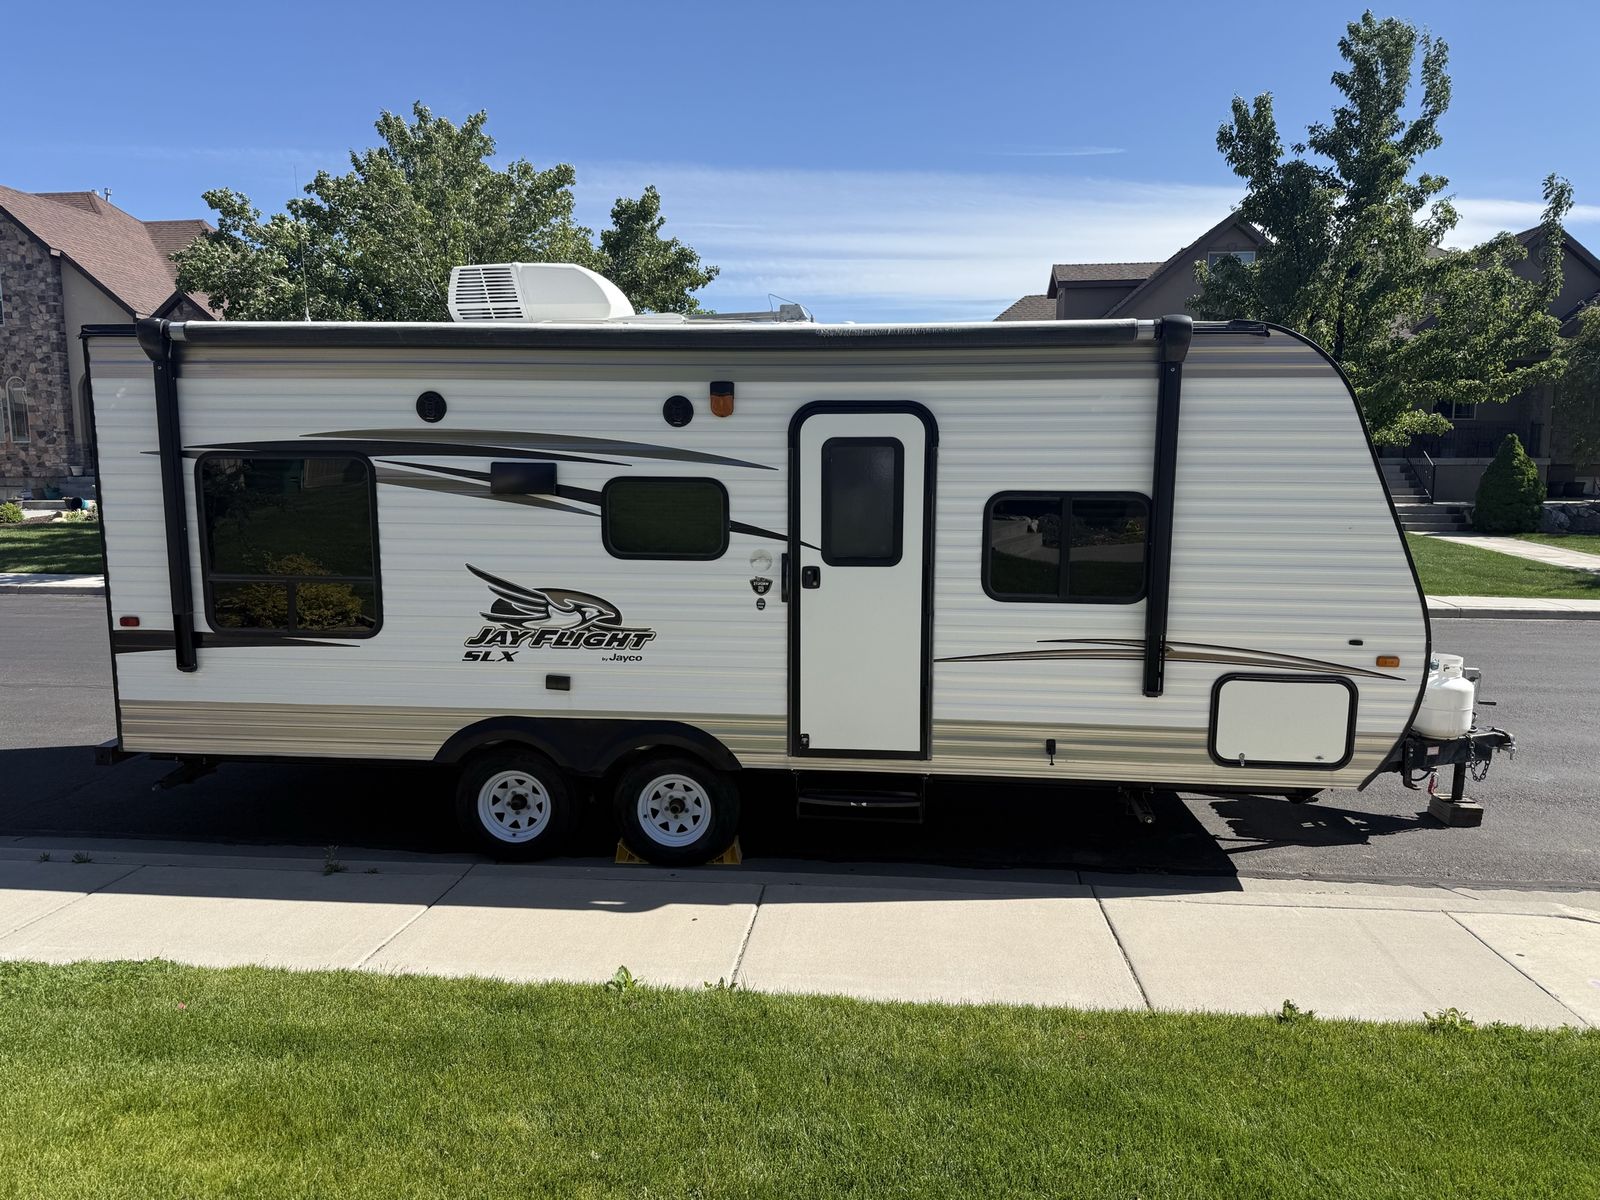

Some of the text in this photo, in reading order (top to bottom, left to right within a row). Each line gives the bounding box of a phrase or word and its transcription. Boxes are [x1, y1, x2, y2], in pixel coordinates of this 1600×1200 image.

[465, 626, 656, 650] JAY FLIGHT
[462, 651, 519, 662] SLX
[609, 653, 643, 663] Jayco
